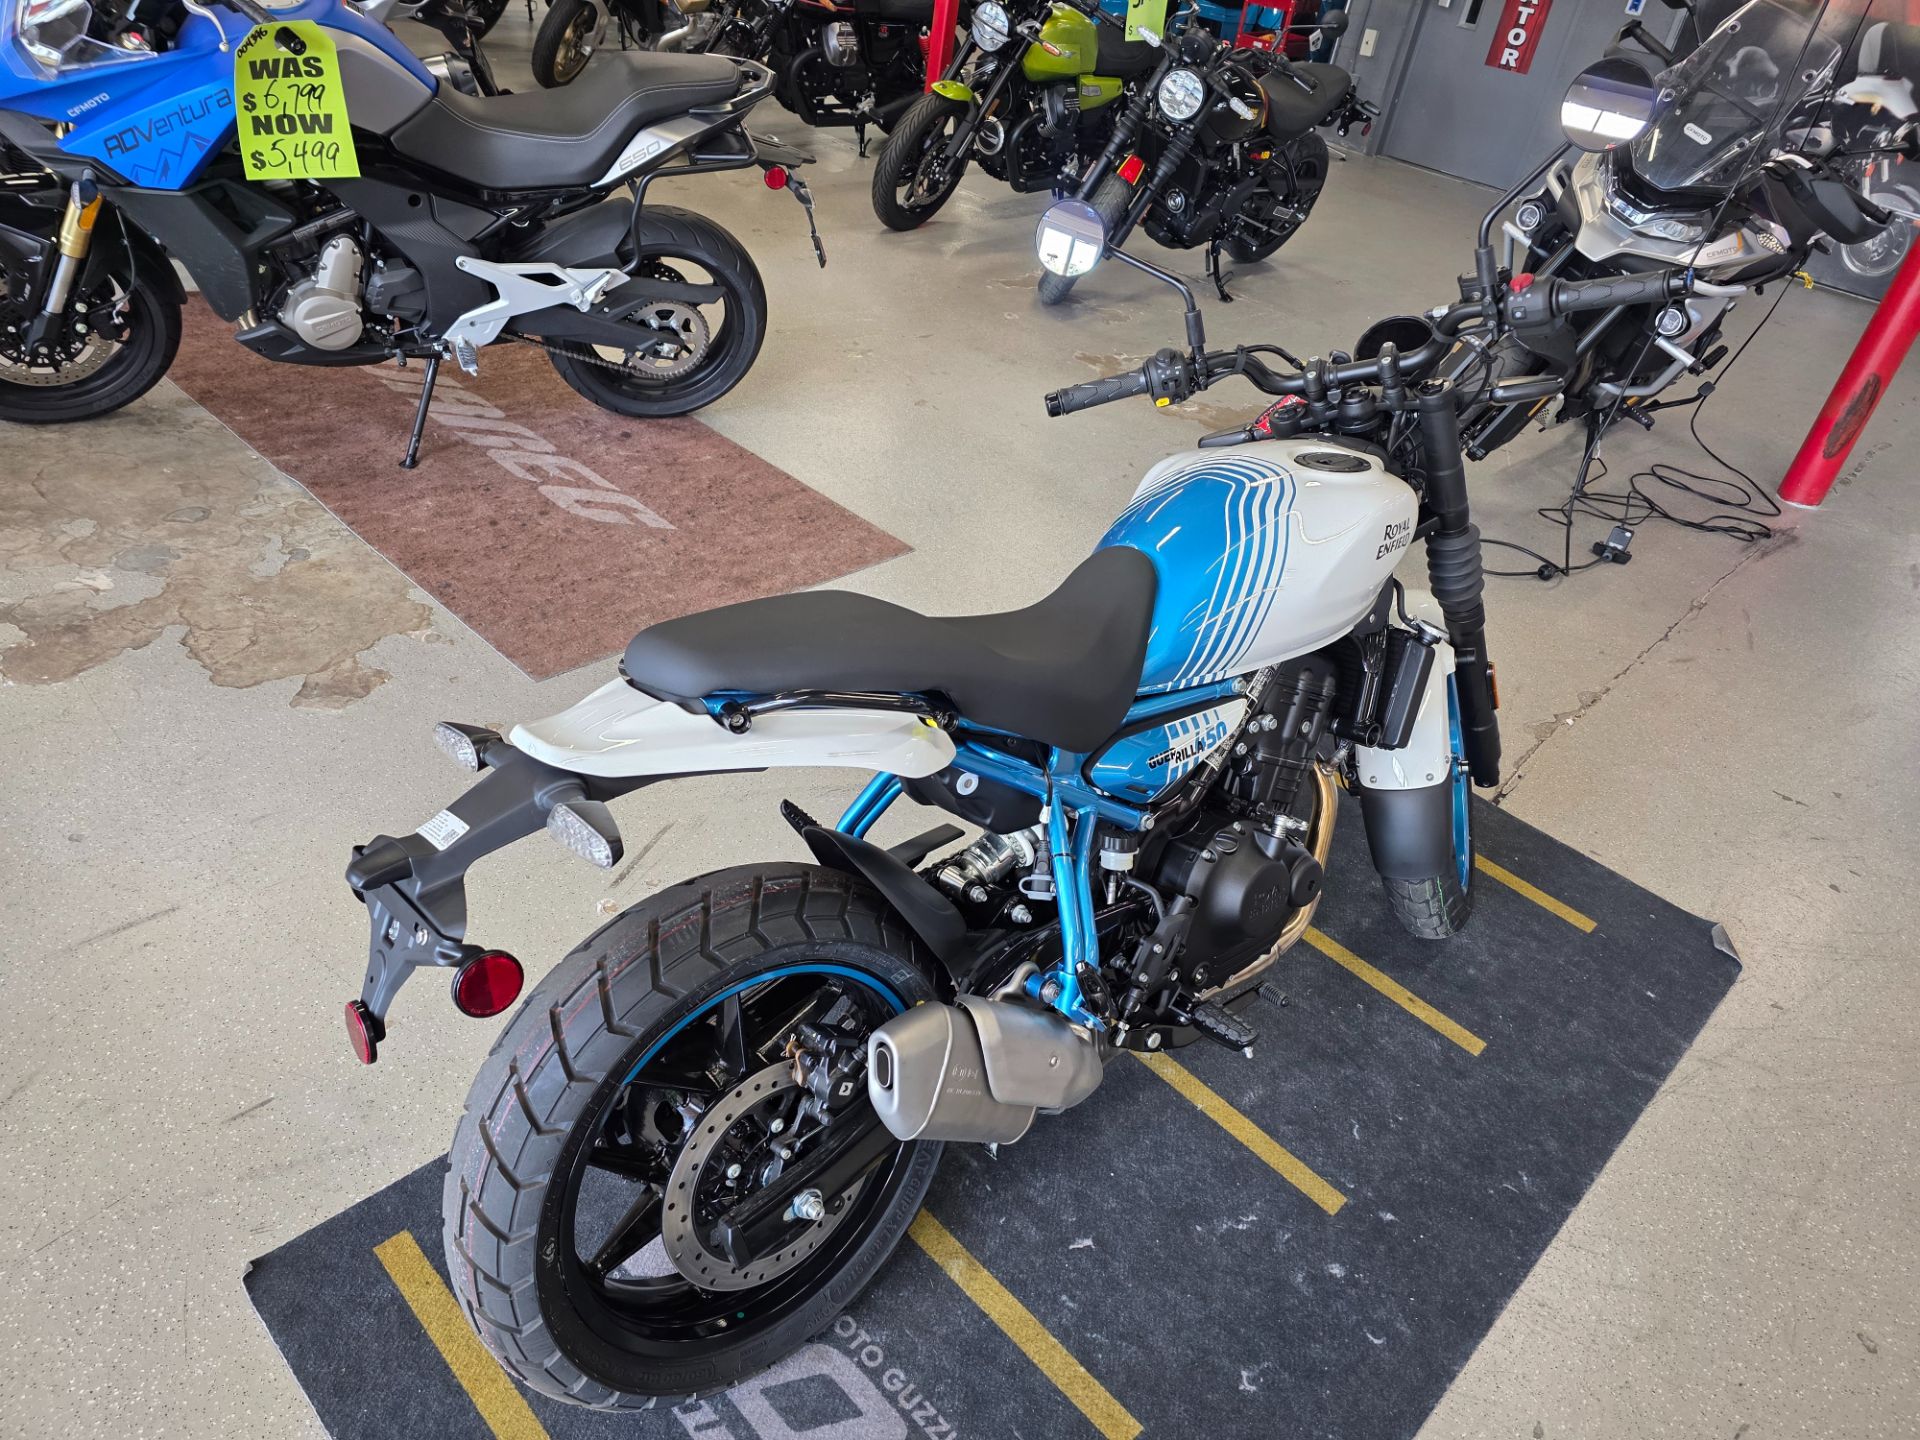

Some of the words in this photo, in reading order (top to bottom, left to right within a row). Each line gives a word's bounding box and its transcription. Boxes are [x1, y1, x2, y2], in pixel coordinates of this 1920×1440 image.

[1500, 0, 1540, 67] TOR
[249, 56, 324, 80] WAS
[67, 92, 110, 117] CFMOTO
[251, 113, 333, 136] NOW
[619, 140, 661, 171] 650
[1384, 517, 1410, 541] ROYAL
[1376, 532, 1411, 560] ENFIELD
[834, 1315, 884, 1367] OTO
